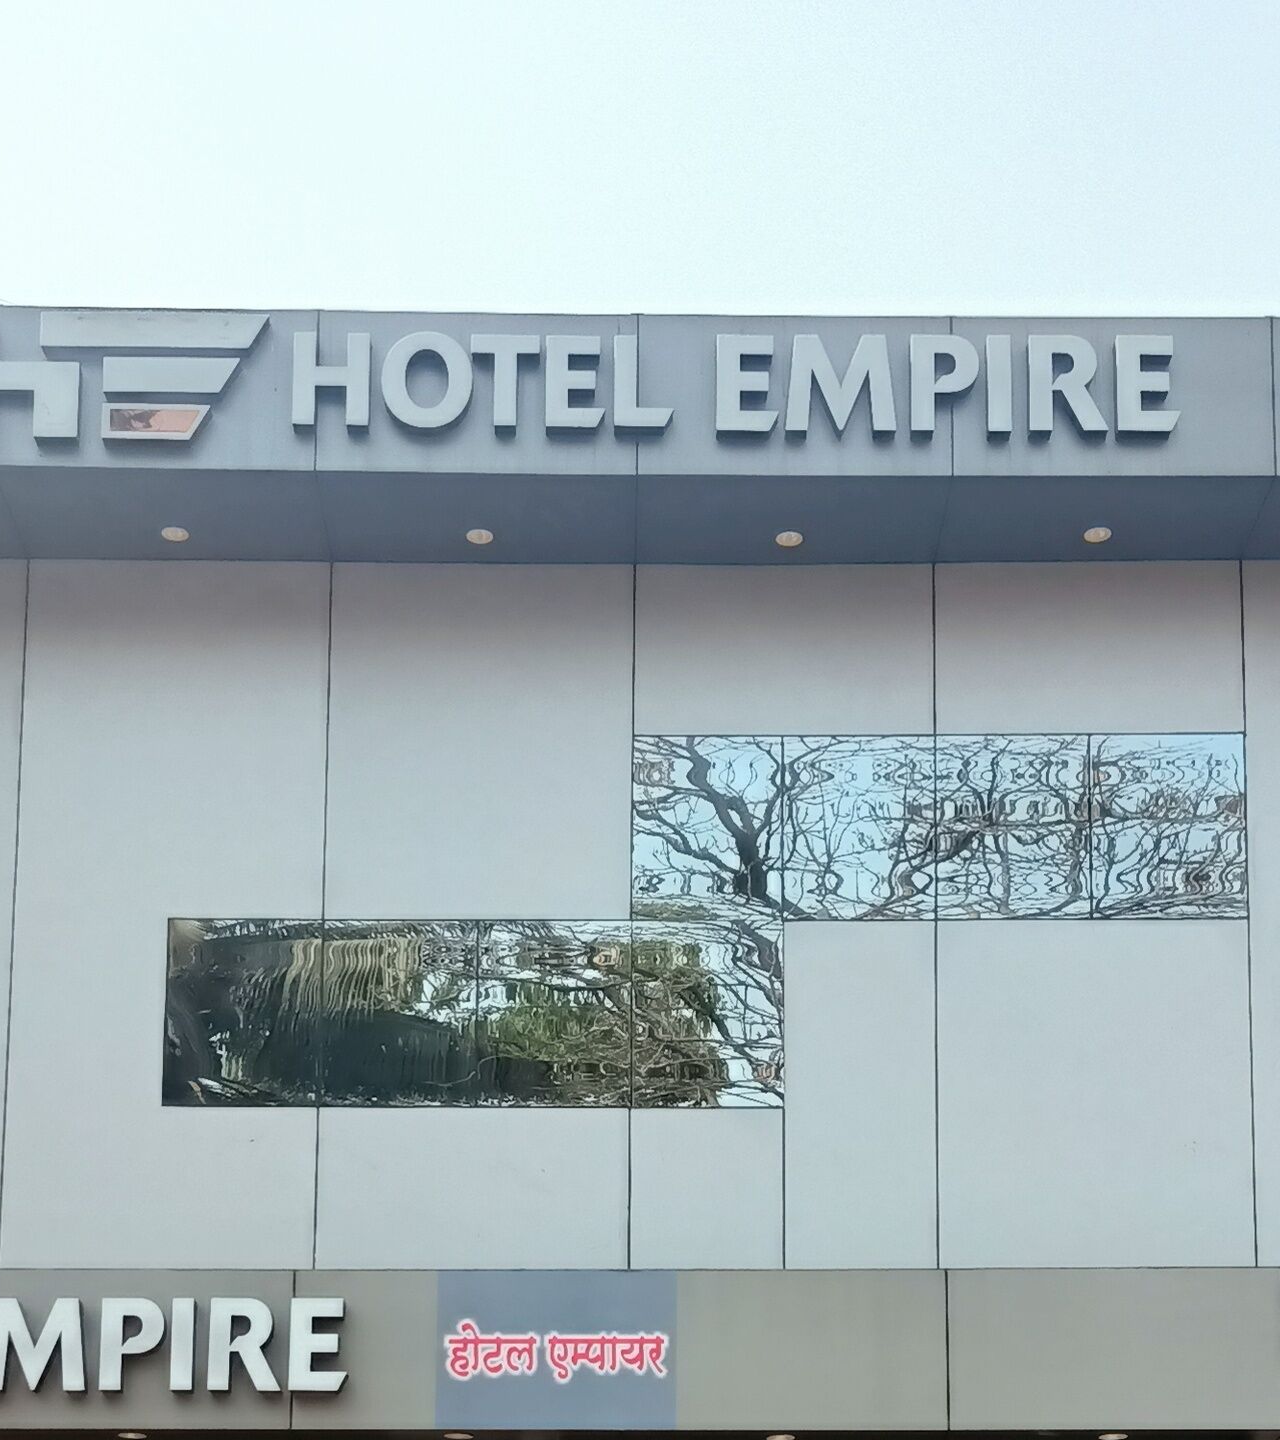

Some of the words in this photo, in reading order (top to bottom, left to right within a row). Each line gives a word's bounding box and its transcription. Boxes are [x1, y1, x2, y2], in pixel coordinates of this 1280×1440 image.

[292, 331, 673, 437] HOTEL
[715, 333, 1182, 440] EMPIRE
[446, 1320, 539, 1380] होटल
[546, 1333, 667, 1382] एम्पायर
